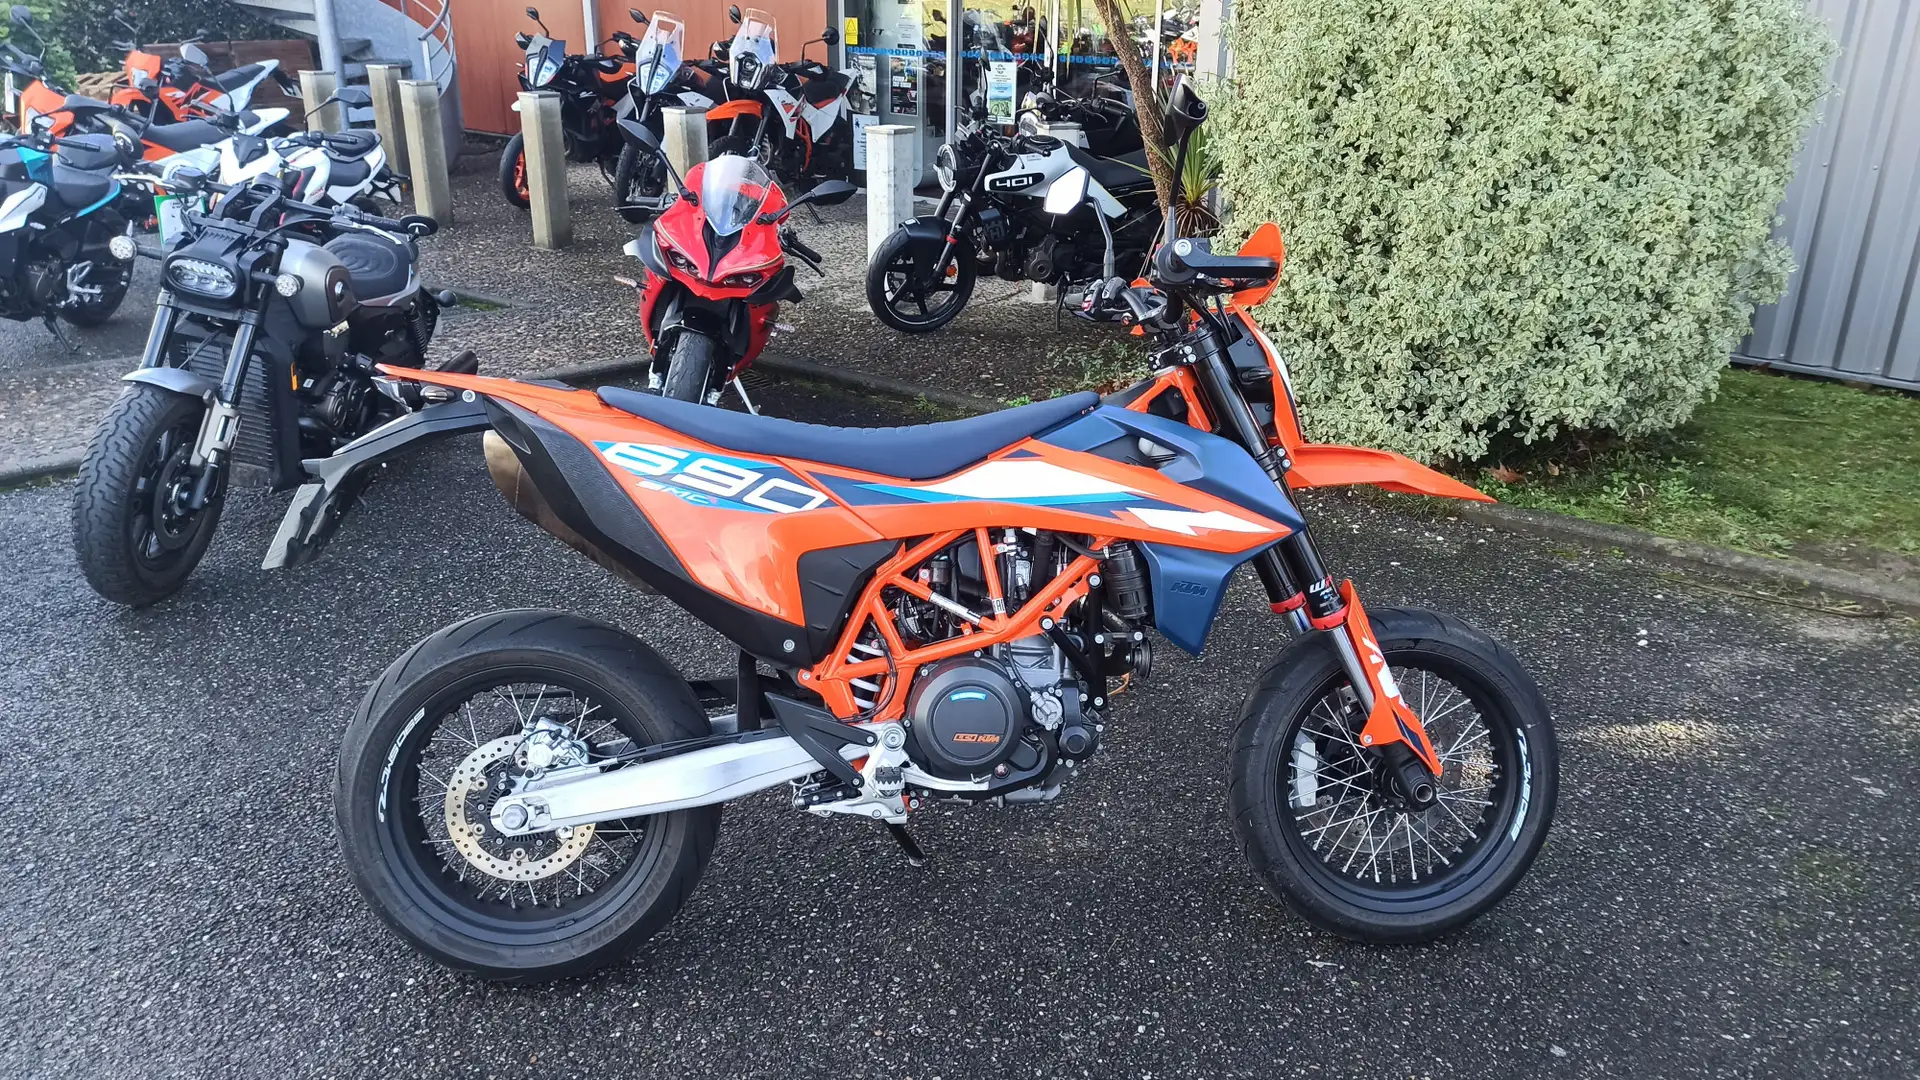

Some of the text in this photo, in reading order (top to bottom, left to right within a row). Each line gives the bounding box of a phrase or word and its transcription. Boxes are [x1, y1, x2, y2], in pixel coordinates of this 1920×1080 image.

[996, 177, 1033, 187] 401
[602, 442, 829, 514] 690
[1170, 580, 1209, 597] KTM
